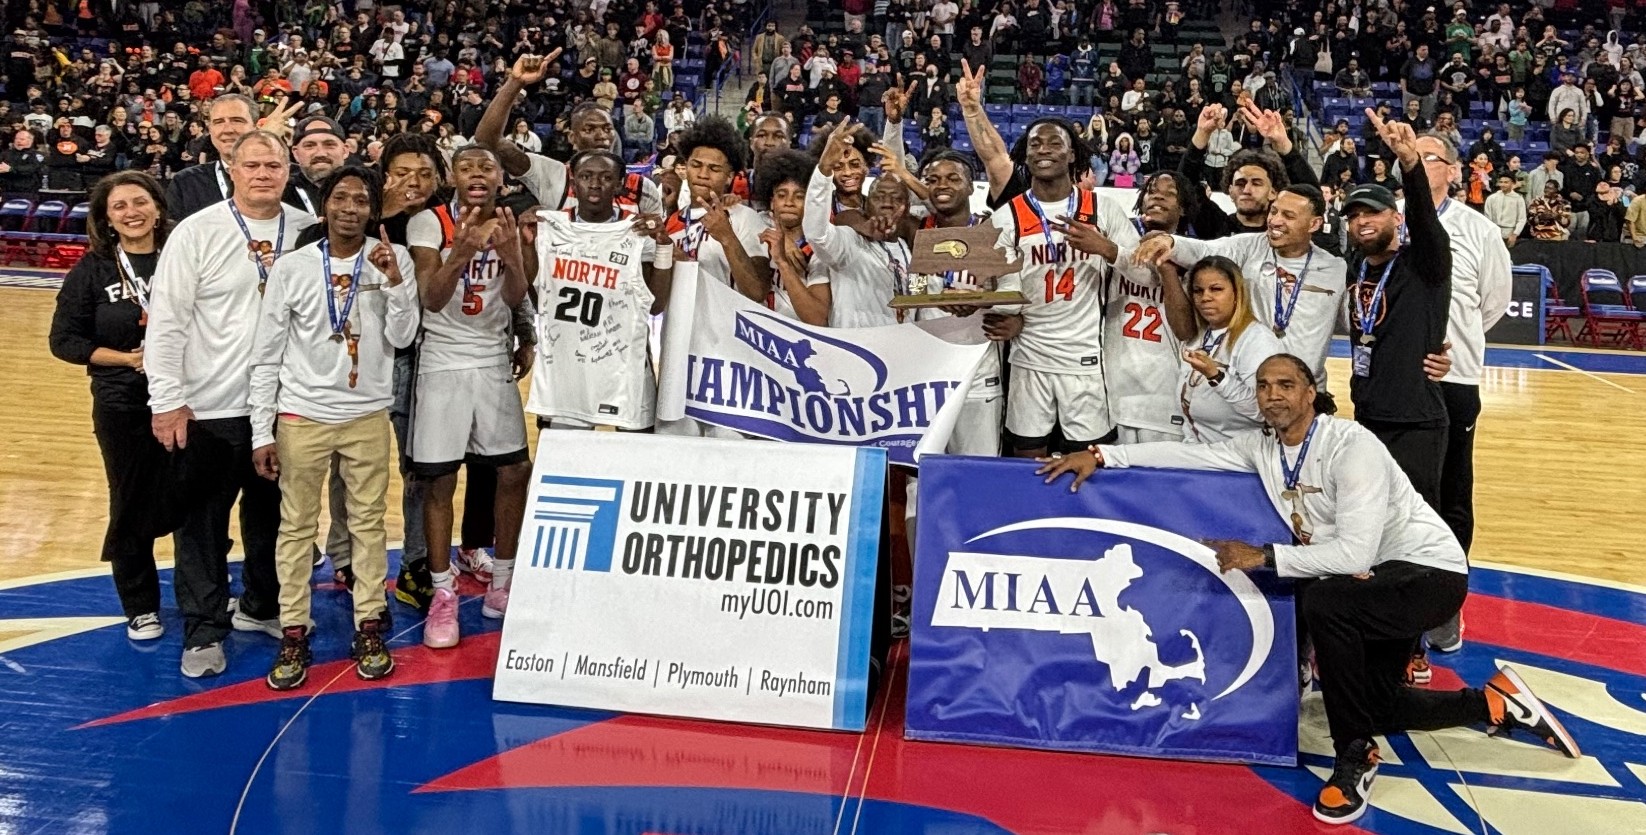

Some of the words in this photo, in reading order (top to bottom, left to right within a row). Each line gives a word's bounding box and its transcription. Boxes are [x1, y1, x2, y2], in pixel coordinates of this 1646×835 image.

[552, 258, 620, 290] NORTH
[610, 252, 629, 266] 297
[462, 285, 486, 315] 5
[1045, 267, 1075, 303] 14
[554, 286, 604, 328] 20
[1122, 302, 1163, 343] 22
[738, 318, 801, 369] MIAA
[686, 353, 962, 437] AMPIONSHI
[630, 481, 847, 536] UNIVERSITY
[621, 531, 842, 589] ORTHOPEDICS
[721, 588, 834, 620] myUOI.com
[951, 568, 1106, 618] MIAA
[505, 649, 555, 673] Easton
[574, 654, 648, 682] Mansfield
[667, 662, 739, 690] Plymouth
[760, 669, 832, 697] Raynham
